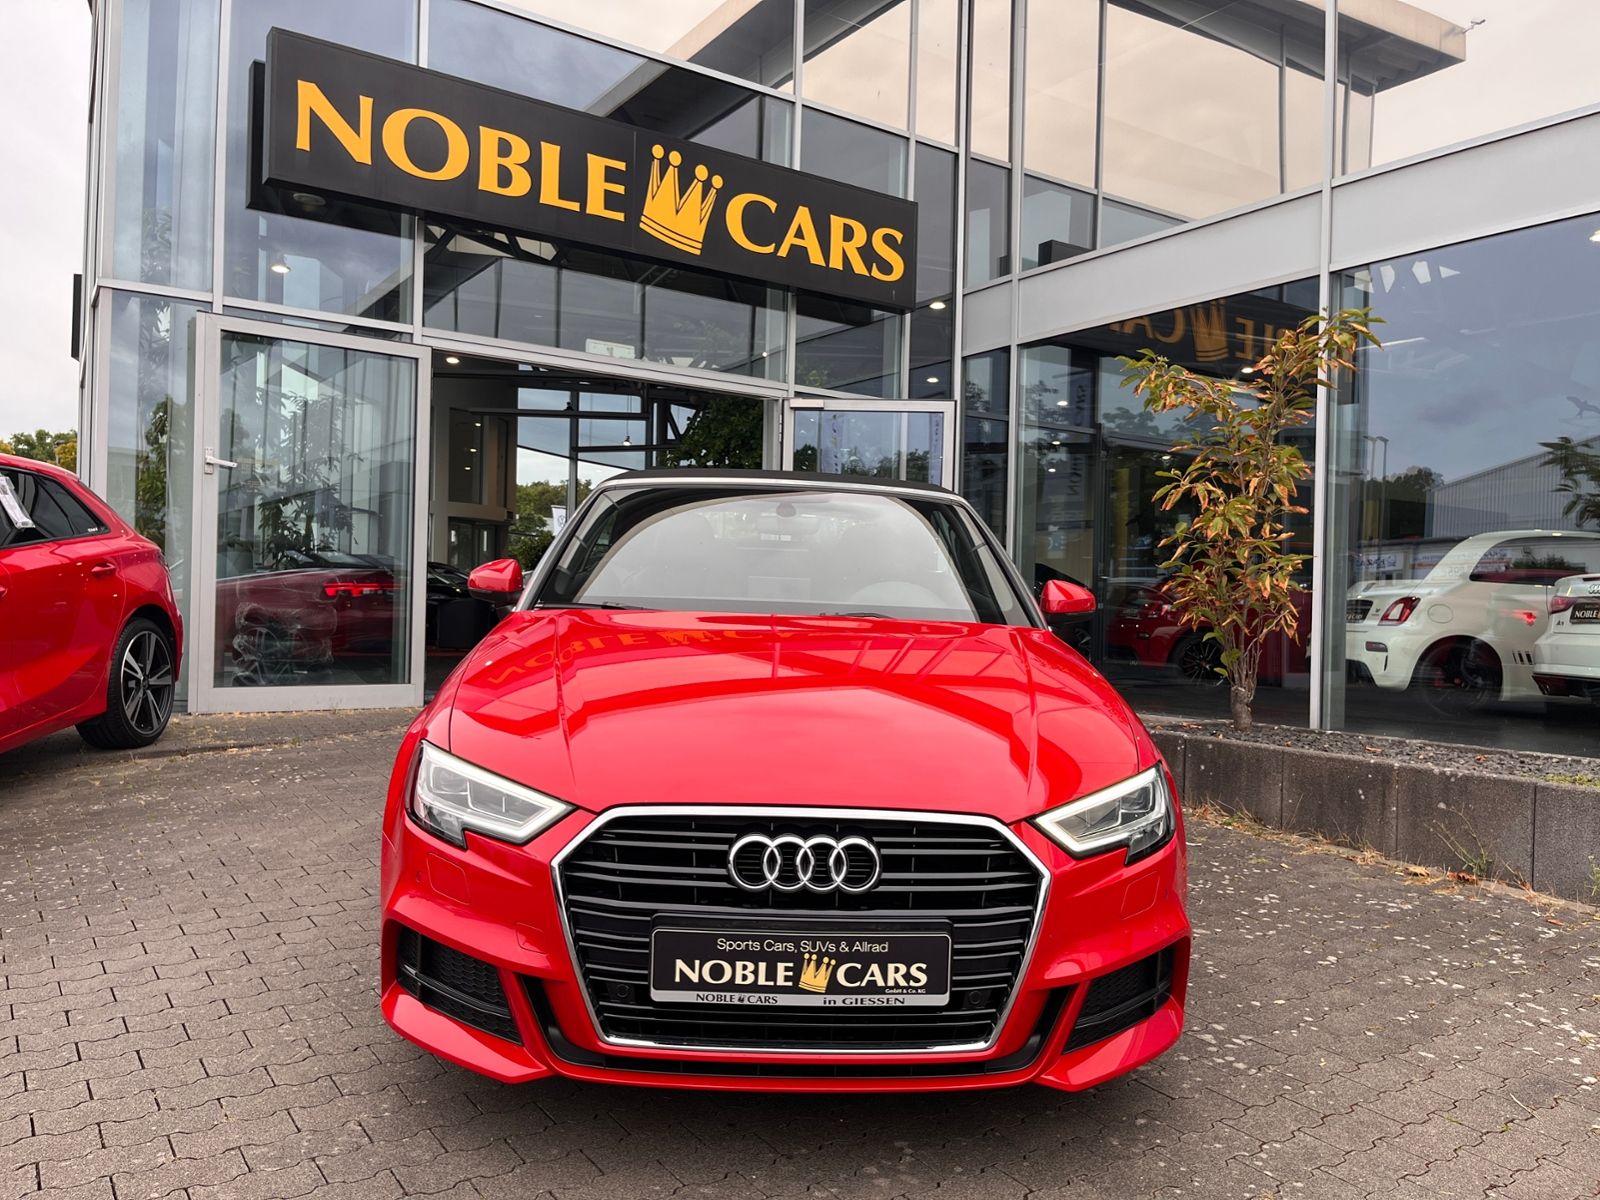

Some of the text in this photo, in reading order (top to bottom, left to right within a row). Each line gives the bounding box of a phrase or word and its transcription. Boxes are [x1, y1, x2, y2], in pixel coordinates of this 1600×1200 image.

[295, 79, 905, 282] NOBLE CARS
[717, 938, 889, 953] Sports Cars, SUVs & Allrad
[674, 958, 928, 987] NOBLE CARS
[696, 993, 778, 1004] NOBLE CARS
[823, 997, 905, 1006] in GIESSEN
